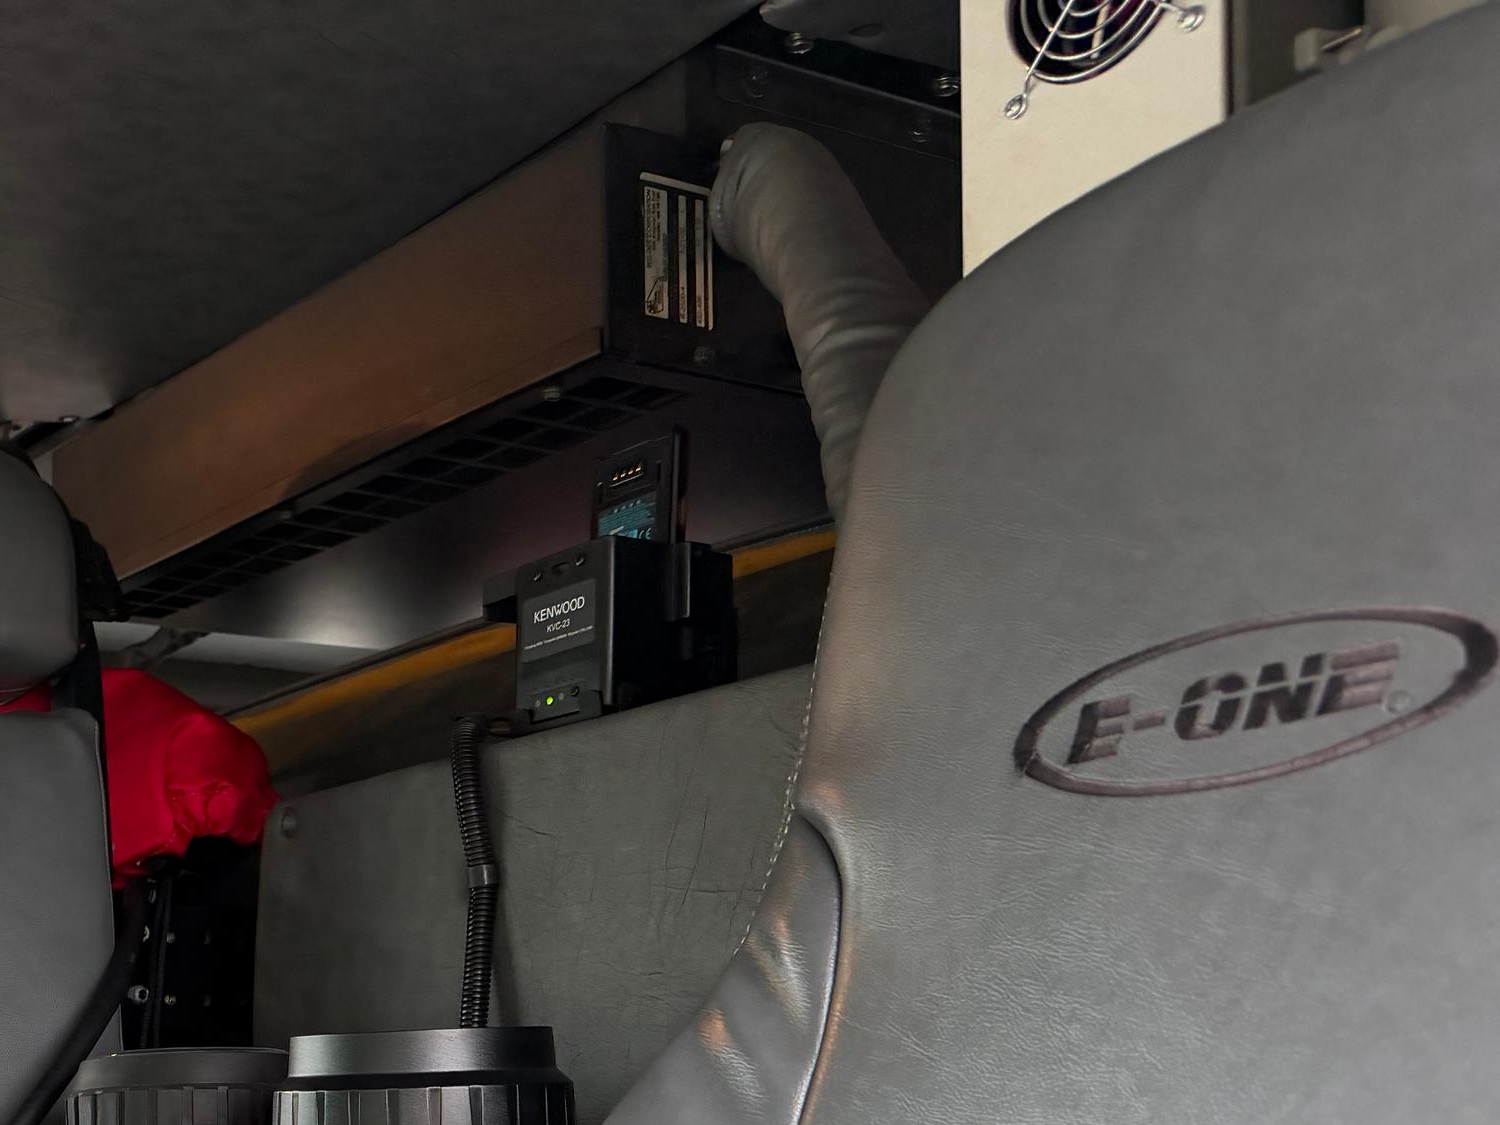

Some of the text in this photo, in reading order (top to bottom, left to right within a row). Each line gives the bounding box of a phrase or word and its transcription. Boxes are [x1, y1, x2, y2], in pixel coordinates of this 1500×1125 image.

[533, 596, 585, 624] KENWOOD
[546, 618, 571, 633] KVC-23
[1066, 640, 1400, 765] E-ONE
